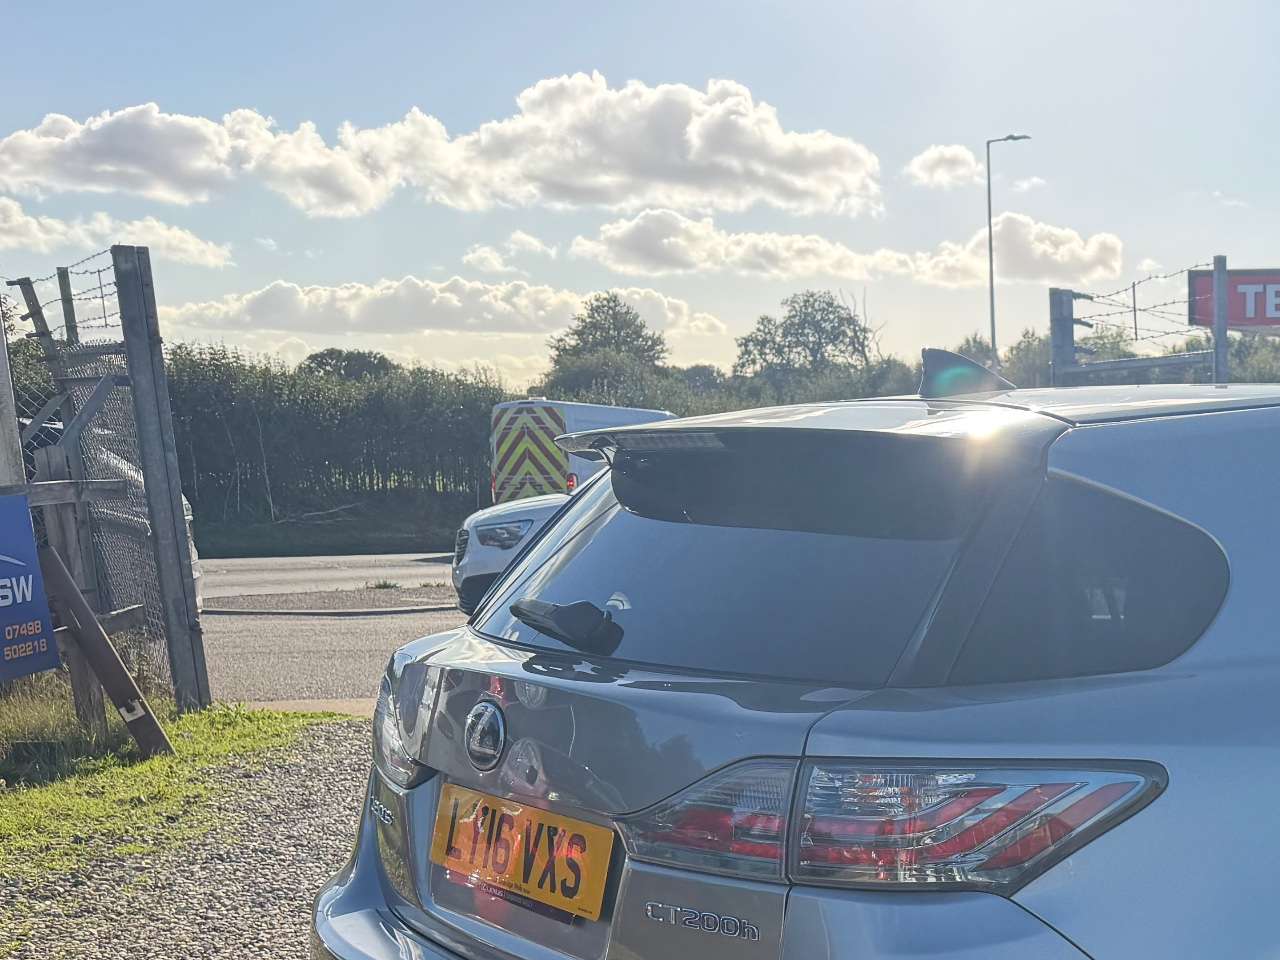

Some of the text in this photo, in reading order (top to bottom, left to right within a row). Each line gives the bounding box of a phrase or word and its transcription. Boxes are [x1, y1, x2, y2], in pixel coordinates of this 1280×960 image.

[5, 620, 42, 639] 07498
[445, 797, 588, 899] LY16 VXS
[645, 901, 760, 941] CT200h
